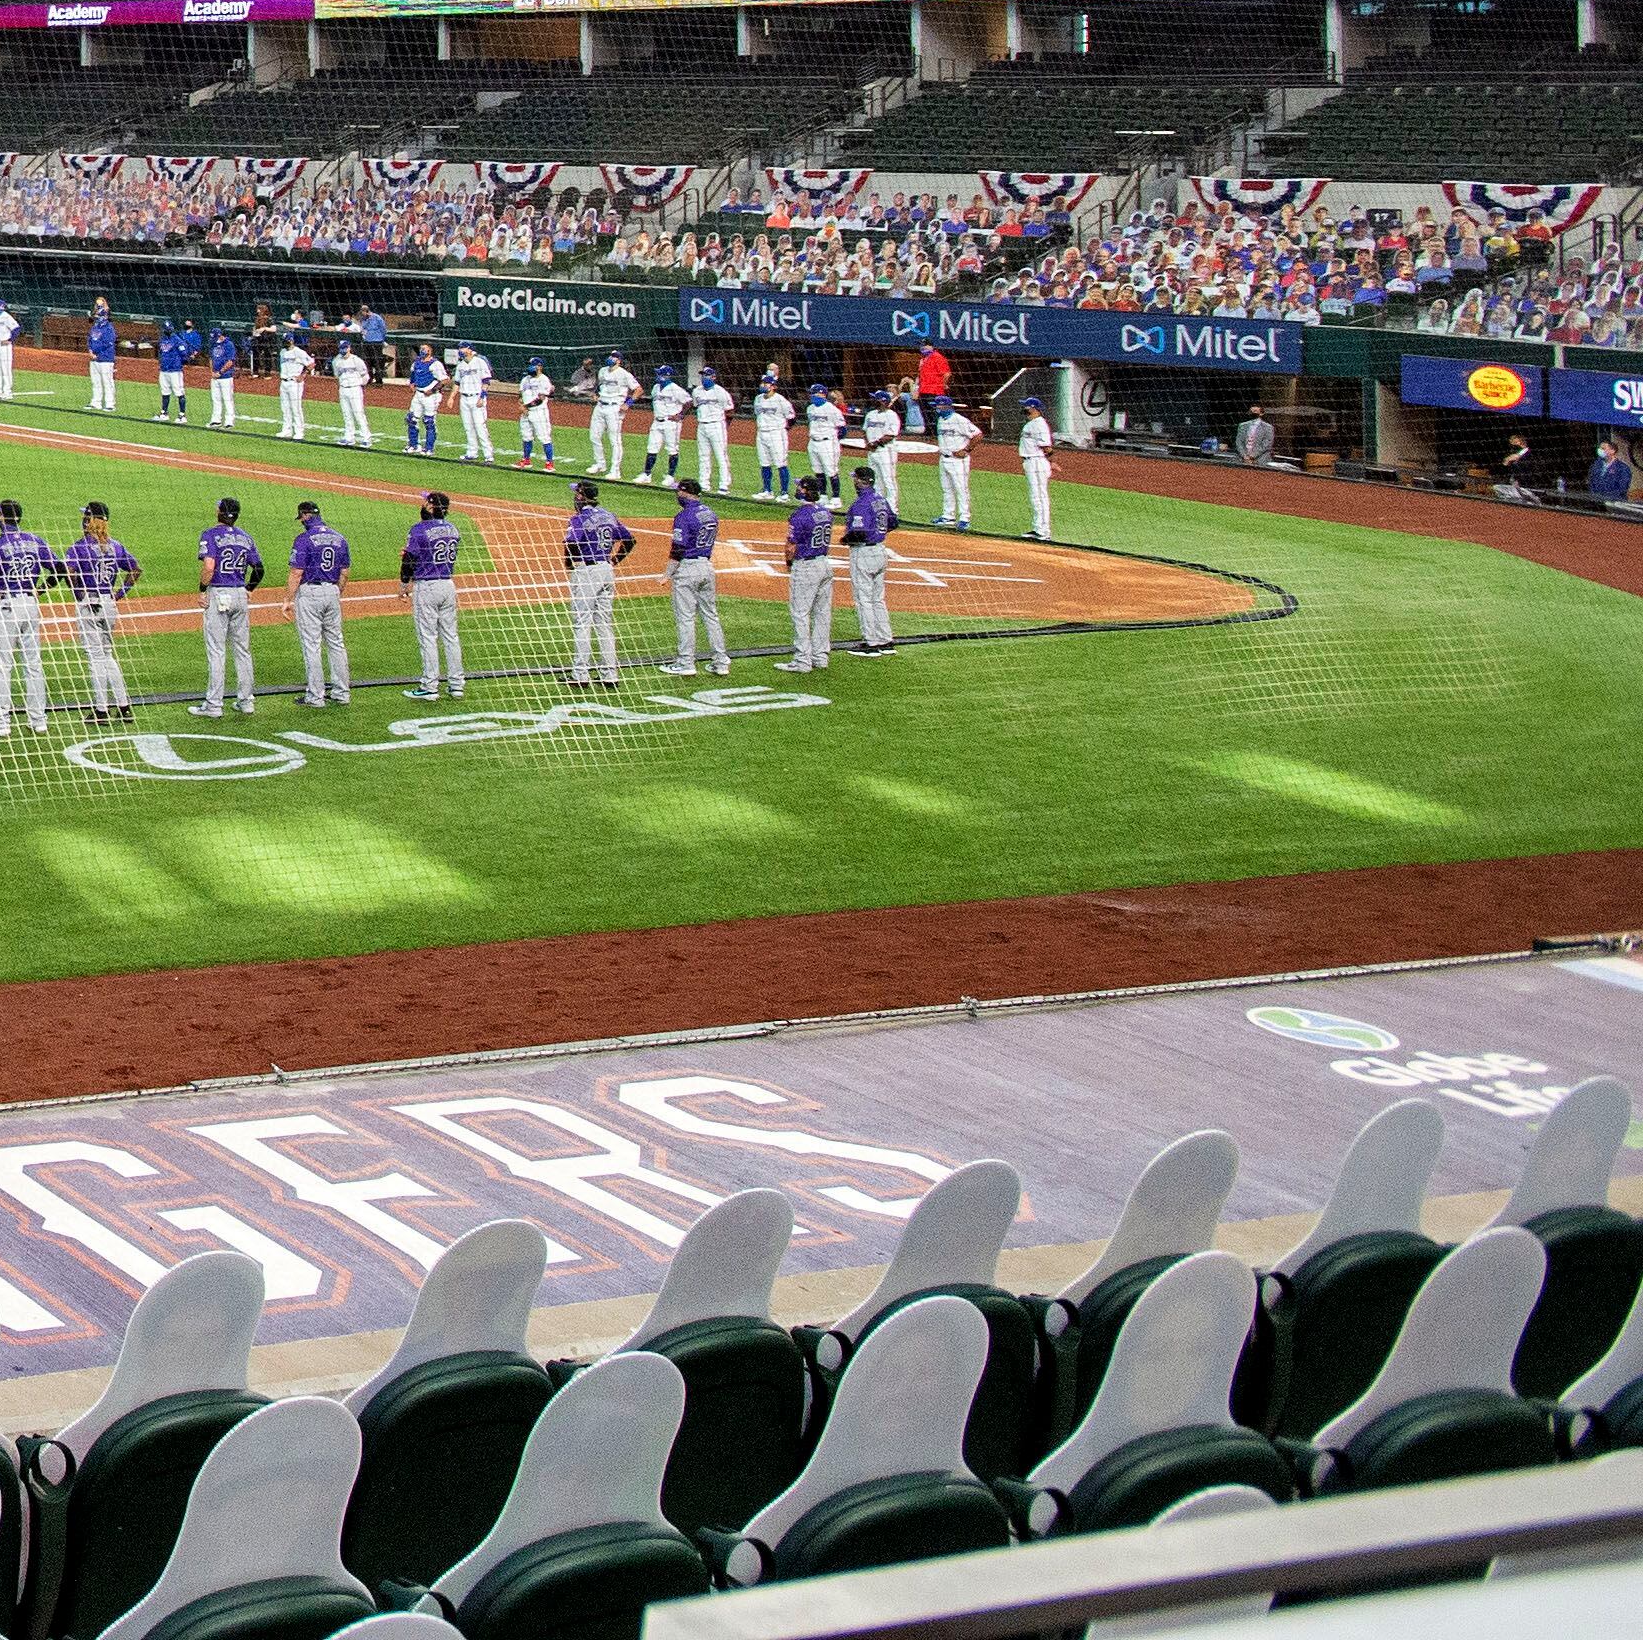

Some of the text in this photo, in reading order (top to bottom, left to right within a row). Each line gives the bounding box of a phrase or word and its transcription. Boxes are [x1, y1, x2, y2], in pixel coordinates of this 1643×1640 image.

[48, 5, 108, 26] Academy
[184, 0, 250, 21] Academy
[1374, 212, 1389, 222] 17
[457, 285, 636, 319] RoofClaim.com
[732, 297, 1279, 363] Mitel Mitel Mitel
[596, 523, 614, 551] 19
[696, 524, 717, 549] 27
[219, 546, 248, 574] 24
[321, 547, 335, 572] 9
[433, 540, 458, 565] 28
[6, 554, 36, 582] 22
[273, 685, 832, 751] LEXUS
[1330, 1050, 1549, 1087] Globe
